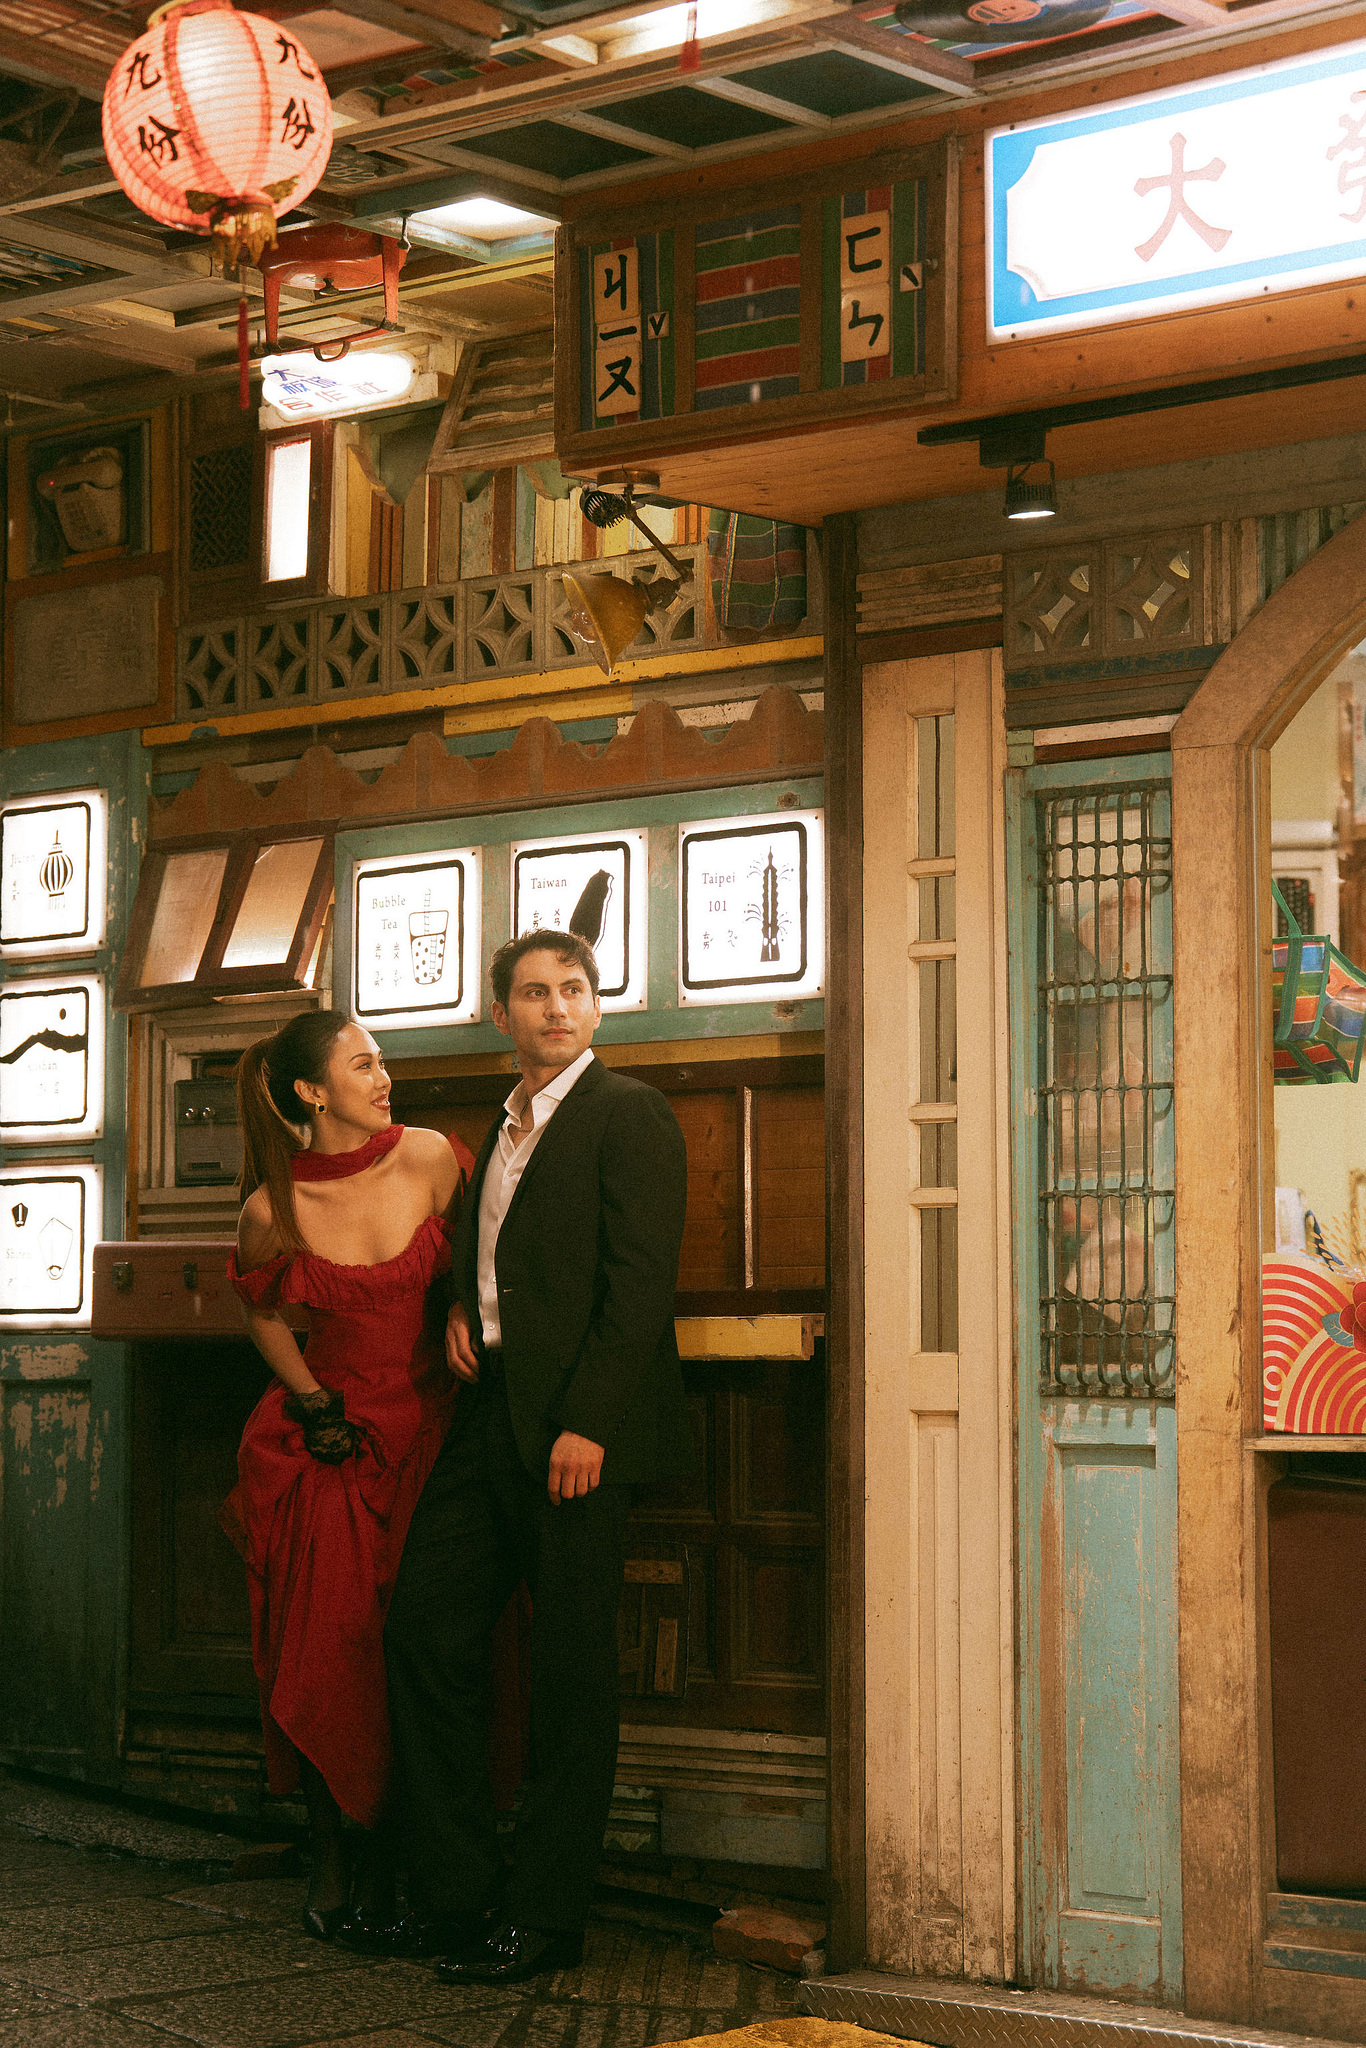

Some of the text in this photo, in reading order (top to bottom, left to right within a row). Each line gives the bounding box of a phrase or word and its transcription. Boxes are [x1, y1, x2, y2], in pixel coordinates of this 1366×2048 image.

[276, 32, 314, 149] 九份
[125, 52, 181, 168] 九份
[279, 381, 388, 410] 合作社
[530, 877, 567, 889] Taiwan
[702, 872, 736, 887] Taipei
[372, 895, 406, 909] Bubble
[708, 900, 727, 912] 101
[381, 919, 398, 930] Tea
